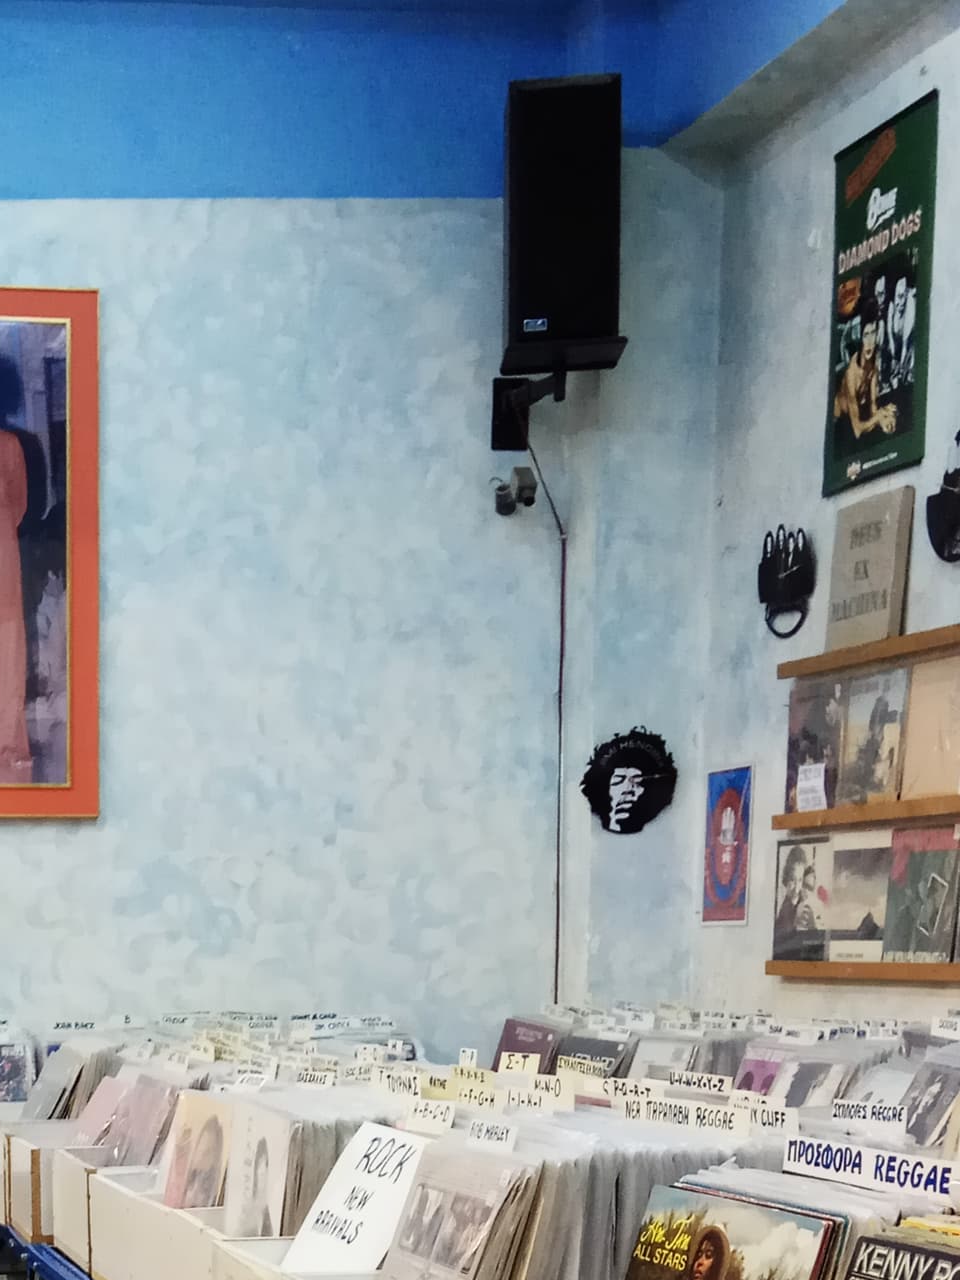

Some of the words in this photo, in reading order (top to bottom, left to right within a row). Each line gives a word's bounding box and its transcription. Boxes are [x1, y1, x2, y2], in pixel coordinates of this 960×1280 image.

[354, 1136, 417, 1185] ROCK
[787, 1139, 863, 1175] ΠΡΟΣΦΟΡΑ
[873, 1154, 952, 1195] REGGAE
[343, 1186, 374, 1211] NEW
[313, 1209, 364, 1245] ARRIVALS
[633, 1243, 652, 1263] ALL
[652, 1249, 688, 1271] STARS
